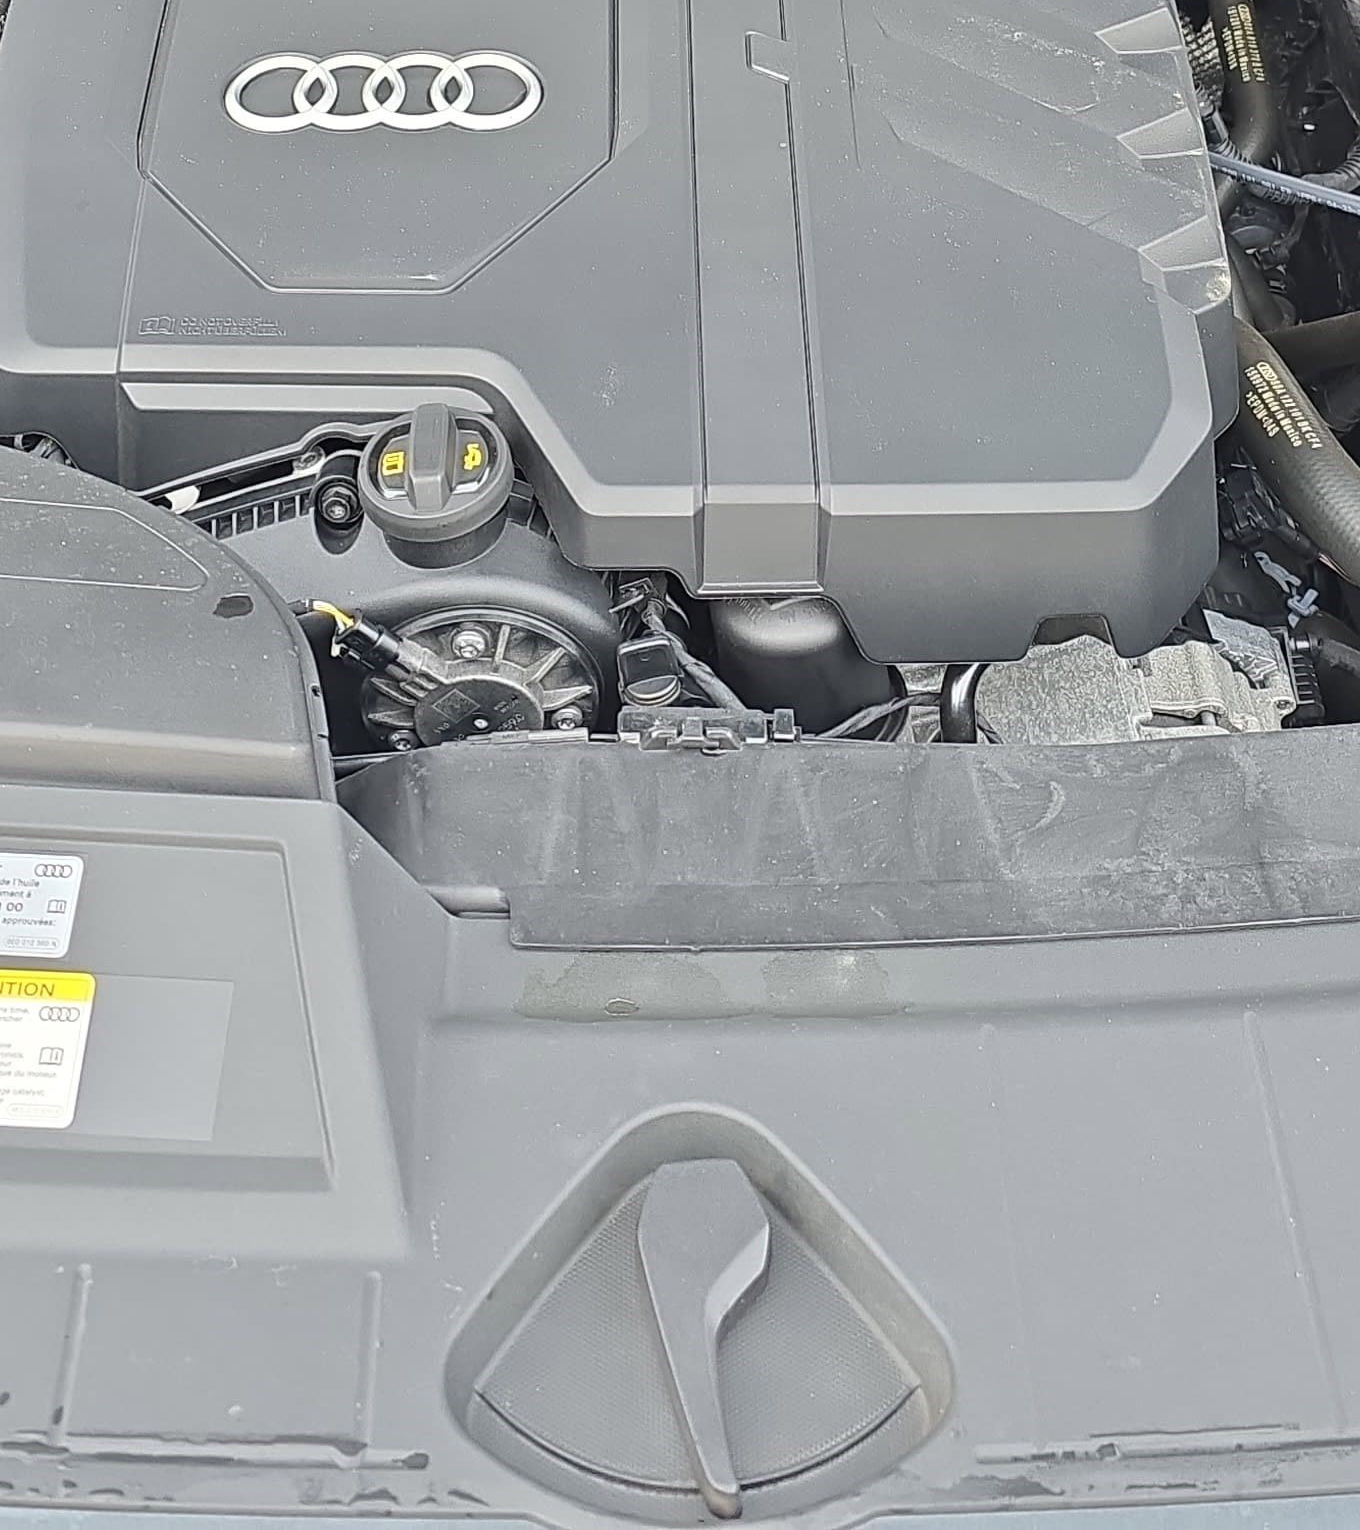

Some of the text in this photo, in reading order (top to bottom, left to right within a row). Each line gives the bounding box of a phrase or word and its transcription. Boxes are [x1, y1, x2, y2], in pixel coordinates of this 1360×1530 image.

[1262, 391, 1281, 412] Made
[1280, 417, 1302, 447] Mexico
[6, 902, 23, 912] 00
